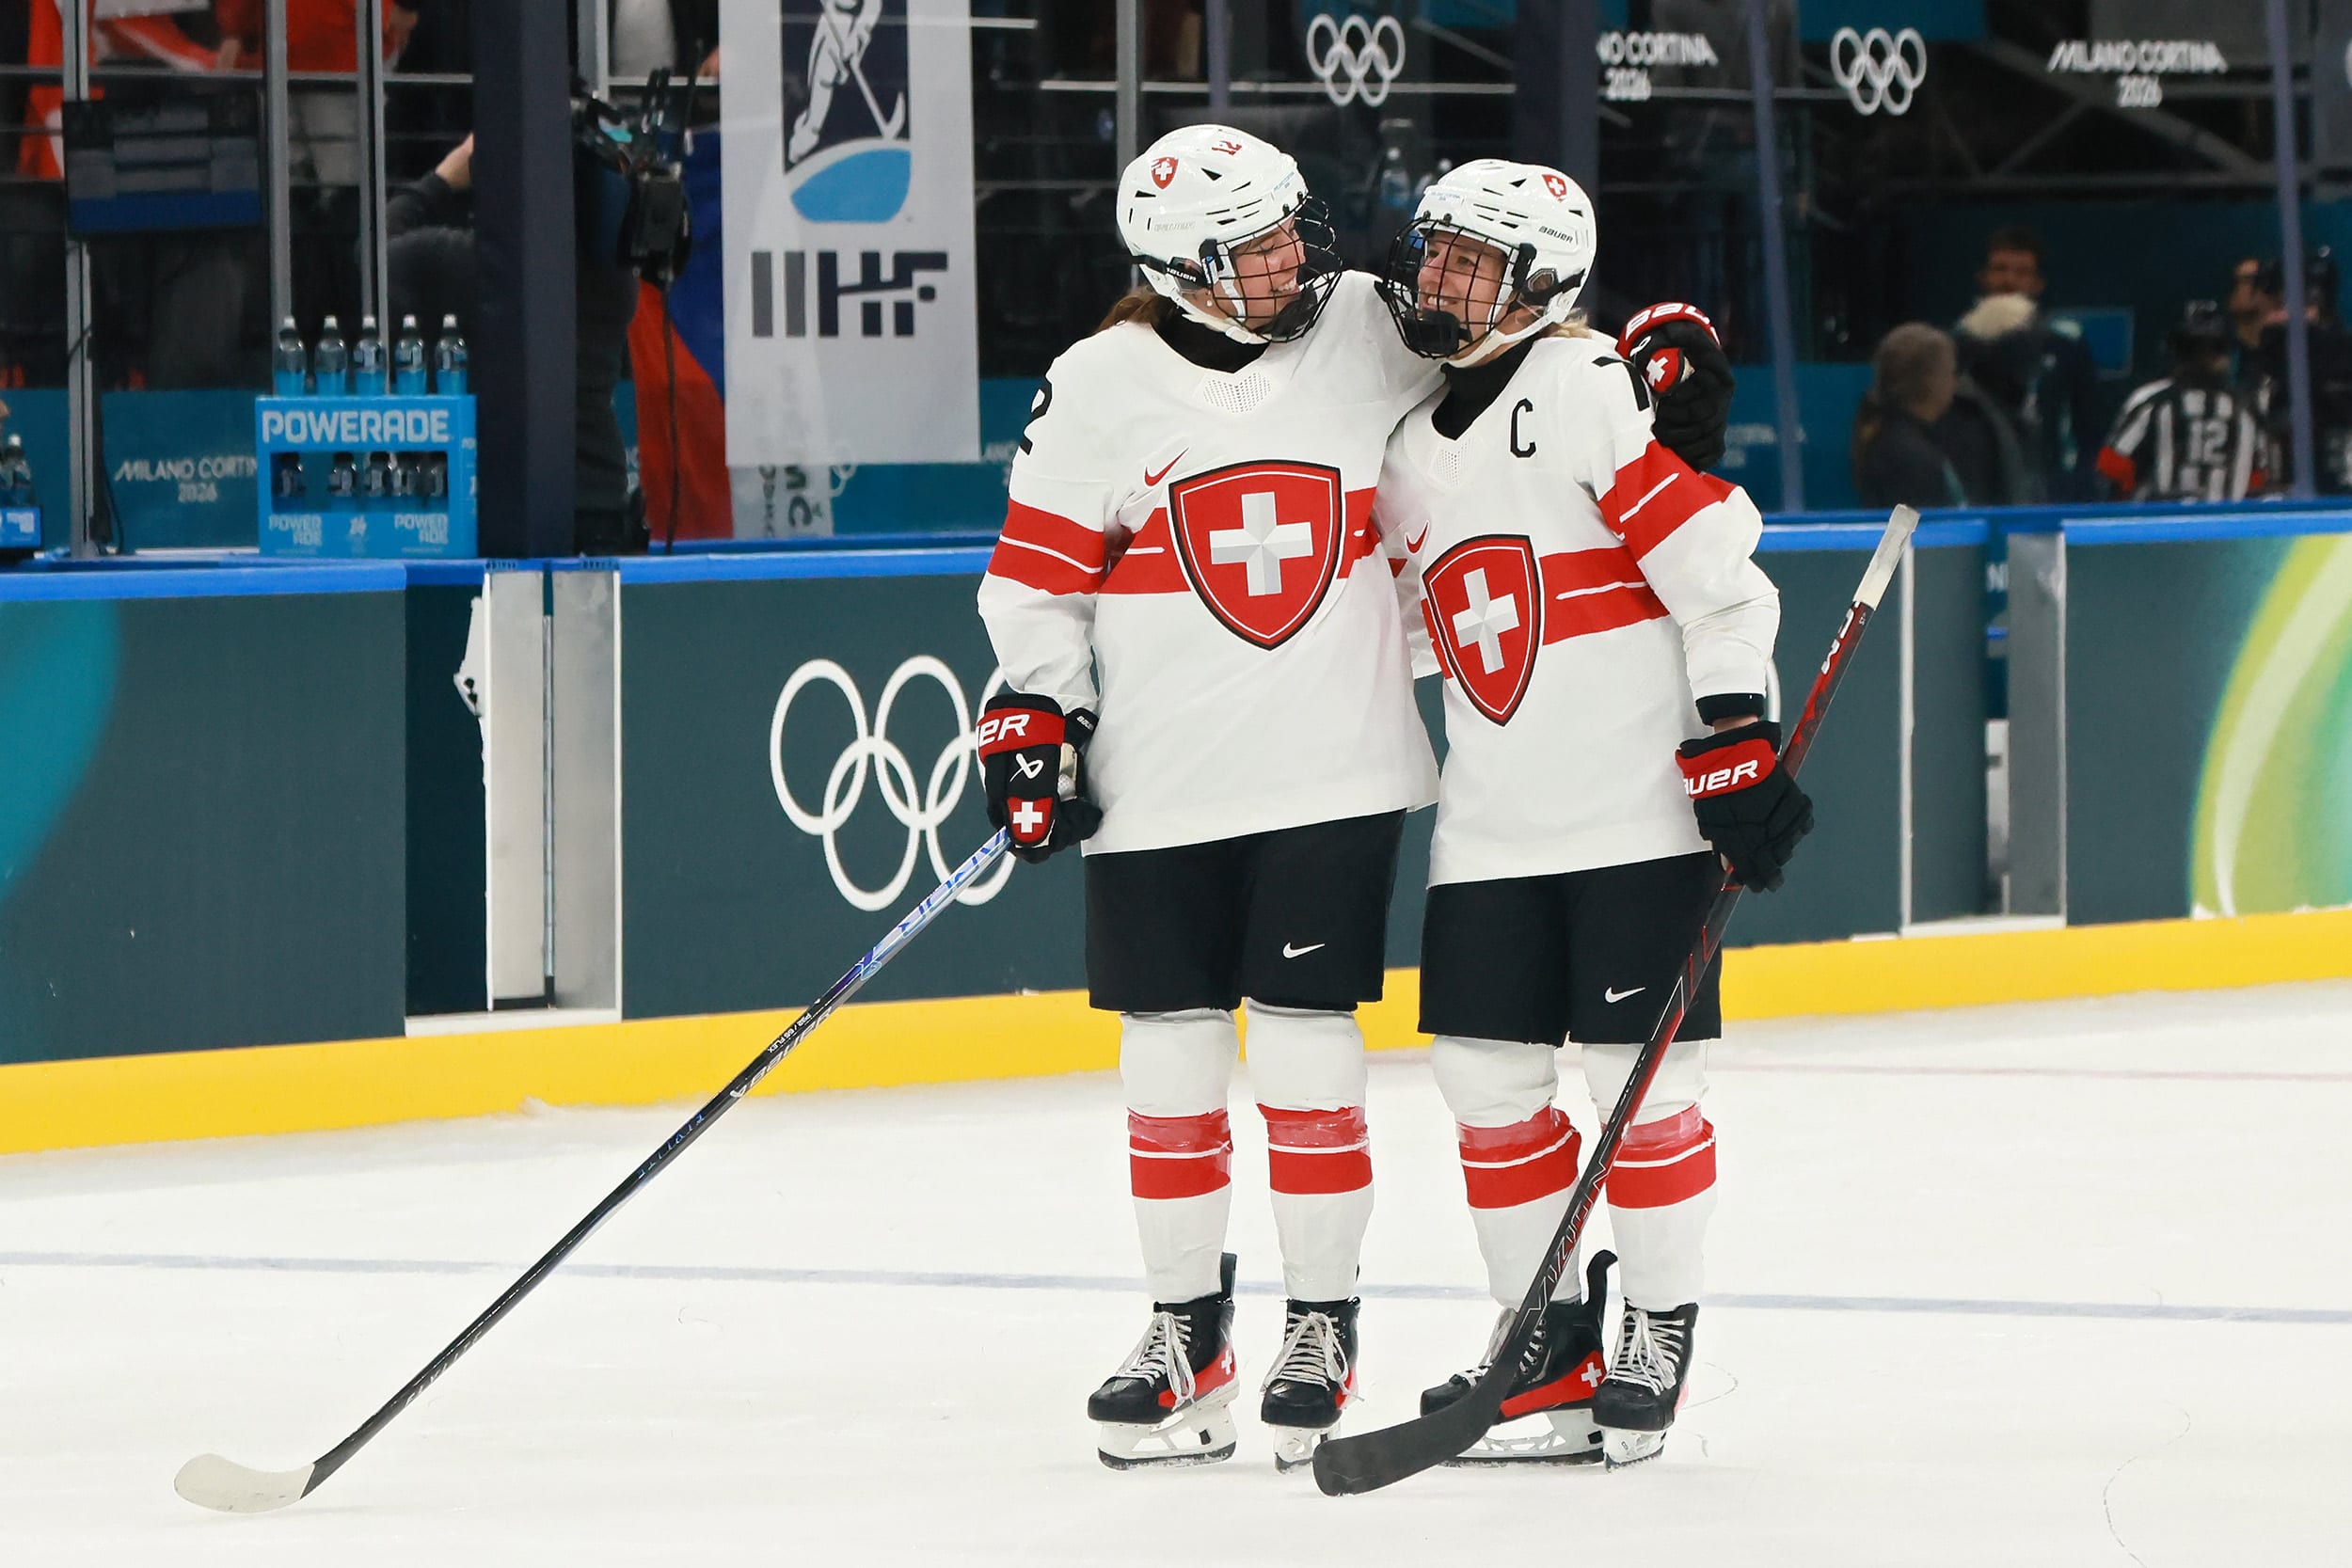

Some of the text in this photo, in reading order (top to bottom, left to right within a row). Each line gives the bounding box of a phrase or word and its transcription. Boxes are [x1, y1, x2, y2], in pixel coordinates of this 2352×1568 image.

[1625, 32, 1719, 66] CORTINA
[2047, 40, 2229, 74] MILANO CORTINA
[1537, 225, 1574, 244] BAUER
[752, 251, 947, 337] IIHF
[262, 410, 450, 443] POWERADE
[1510, 397, 1537, 458] C
[2189, 420, 2229, 463] 12
[113, 460, 196, 482] MILANO
[269, 515, 322, 531] POWER
[394, 514, 449, 530] POWER
[767, 1036, 787, 1053] FLEX
